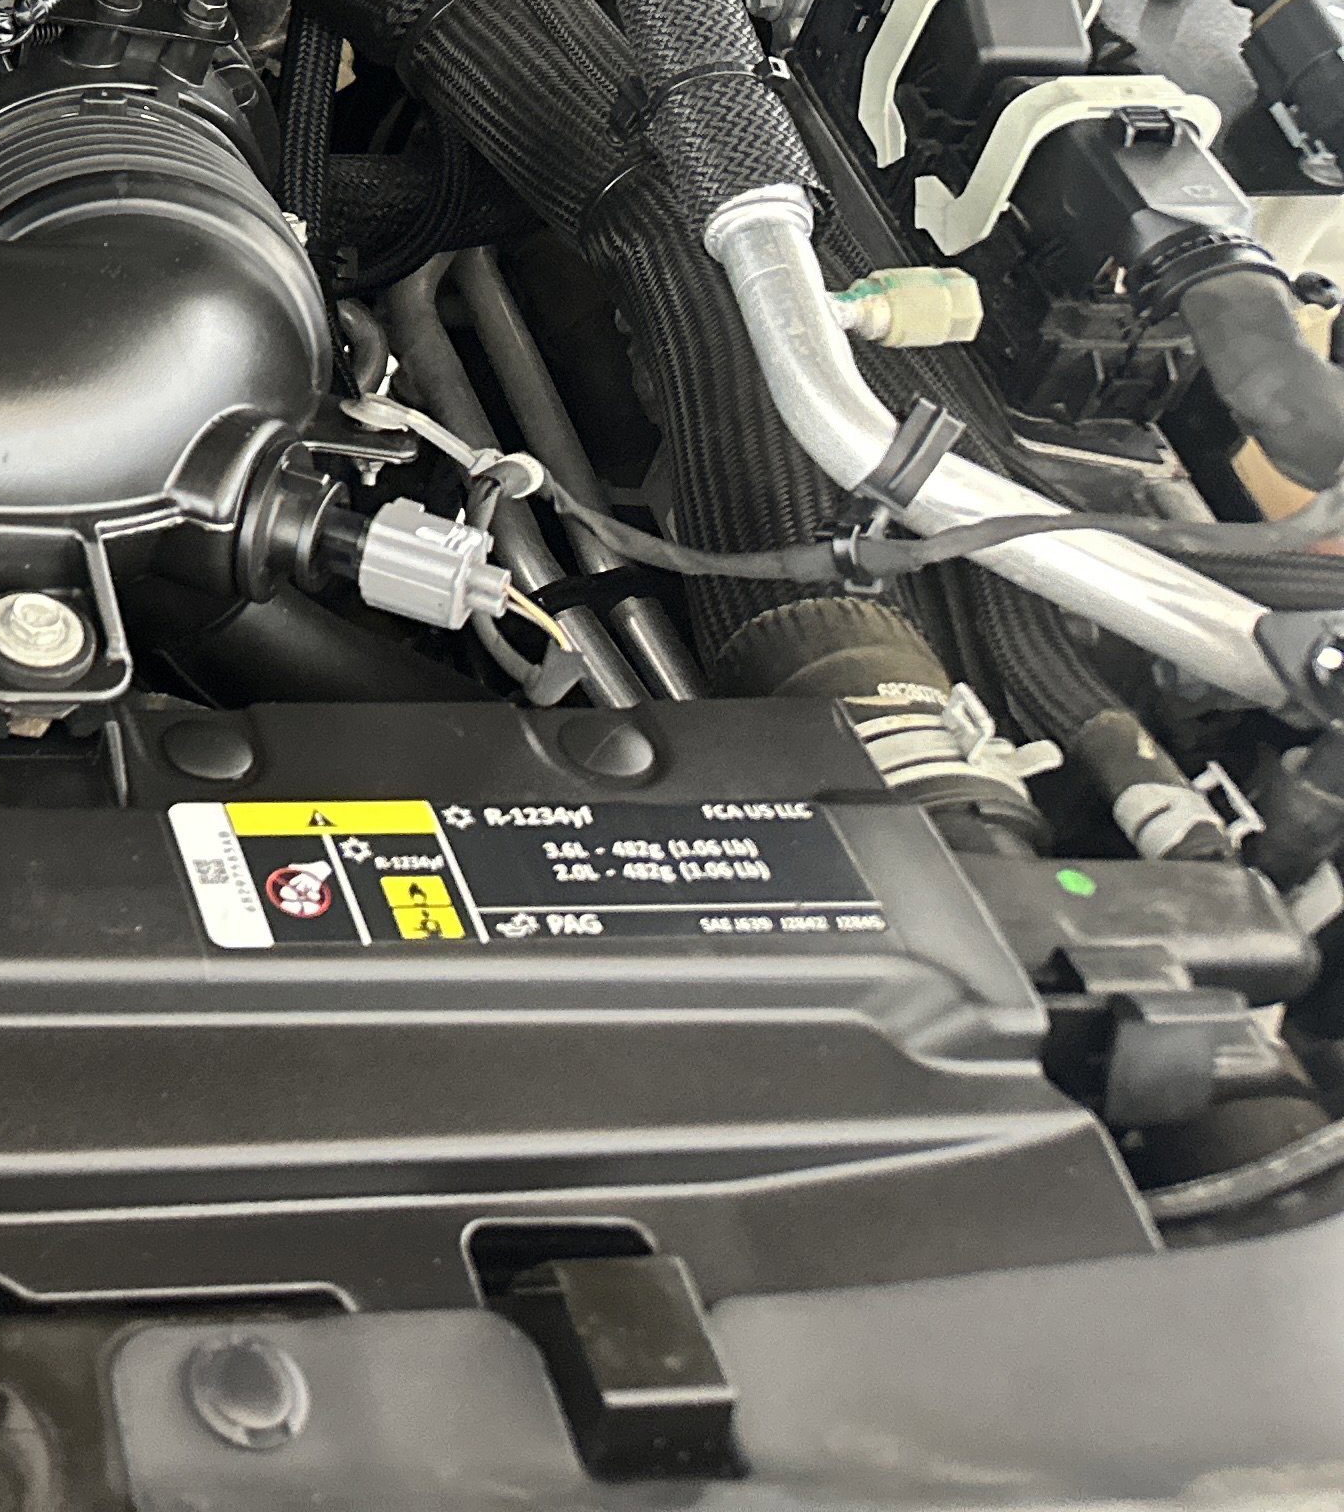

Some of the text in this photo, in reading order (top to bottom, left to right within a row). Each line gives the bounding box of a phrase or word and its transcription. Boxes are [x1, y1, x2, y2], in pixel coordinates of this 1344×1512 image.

[483, 805, 593, 828] R-1234yf
[702, 802, 813, 820] FCA US LLC
[542, 842, 590, 859] 3.6L
[612, 840, 665, 860] 482g
[552, 863, 600, 881] 2.0L
[623, 862, 677, 883] 482g
[546, 913, 604, 935] PAG
